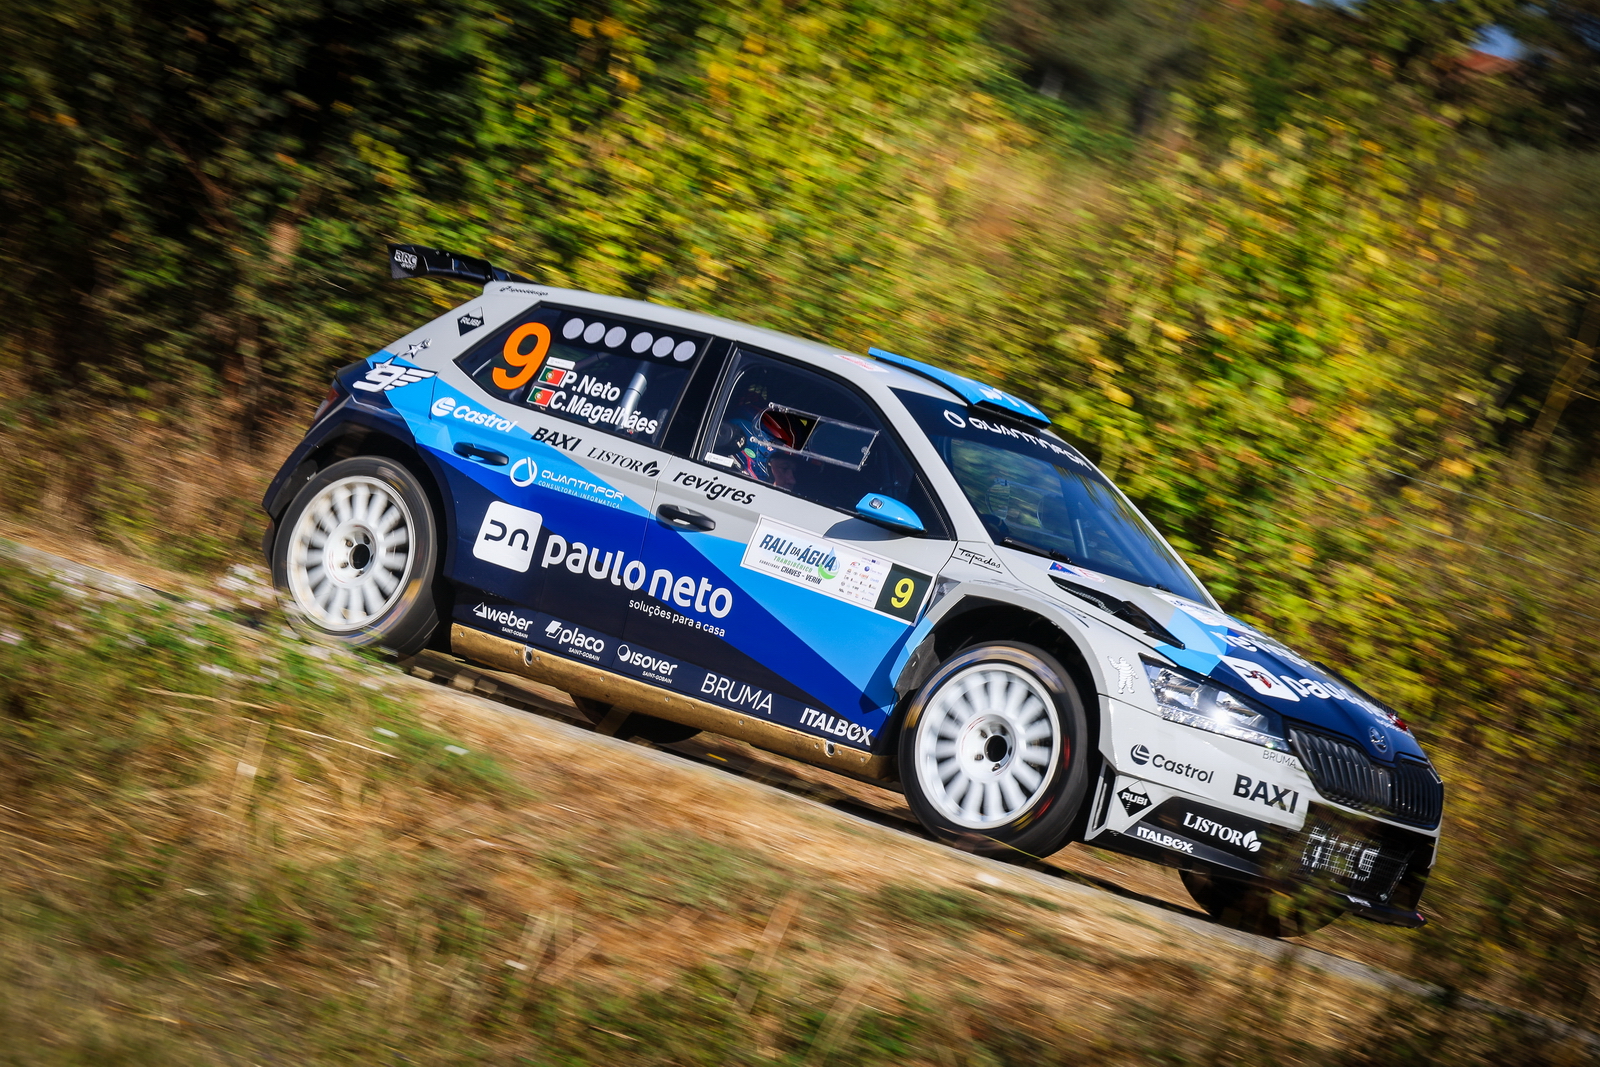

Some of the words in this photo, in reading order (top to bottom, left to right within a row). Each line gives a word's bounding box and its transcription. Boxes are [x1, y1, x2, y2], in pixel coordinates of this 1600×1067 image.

[460, 316, 482, 326] RUBI
[492, 322, 551, 390] 9
[560, 370, 621, 401] P.Neto
[453, 405, 518, 433] Castrol
[550, 390, 658, 435] C.Magalhães
[530, 427, 582, 452] BAXI
[587, 447, 643, 472] LISTOR
[538, 480, 578, 497] CONSULTORIA
[541, 469, 625, 502] QUANTINFOR
[672, 469, 756, 505] revigres
[759, 533, 793, 556] RALI
[797, 545, 837, 572] ÁGUA
[958, 547, 1001, 569] Tapadas
[541, 534, 646, 592] paulo
[648, 568, 733, 619] neto
[780, 565, 802, 578] CHAVES
[890, 577, 915, 609] 9
[487, 607, 533, 632] weber
[628, 599, 672, 616] soluções
[671, 613, 694, 627] para
[695, 621, 701, 629] a
[702, 623, 726, 637] casa
[501, 626, 528, 639] SAINT-GOBAIN
[558, 628, 605, 653] placo
[568, 647, 600, 662] SAINT-GOBAIN
[642, 670, 673, 684] SAINT-GOBAIN
[701, 672, 773, 714] BRUMA
[800, 707, 874, 746] ITALBOX
[1152, 754, 1214, 784] Castrol
[1262, 750, 1297, 769] BRUMA
[1122, 792, 1148, 806] RUBI
[1233, 774, 1299, 814] BAXI
[1136, 826, 1193, 854] ITALBOX
[1183, 812, 1242, 846] LISTOR
